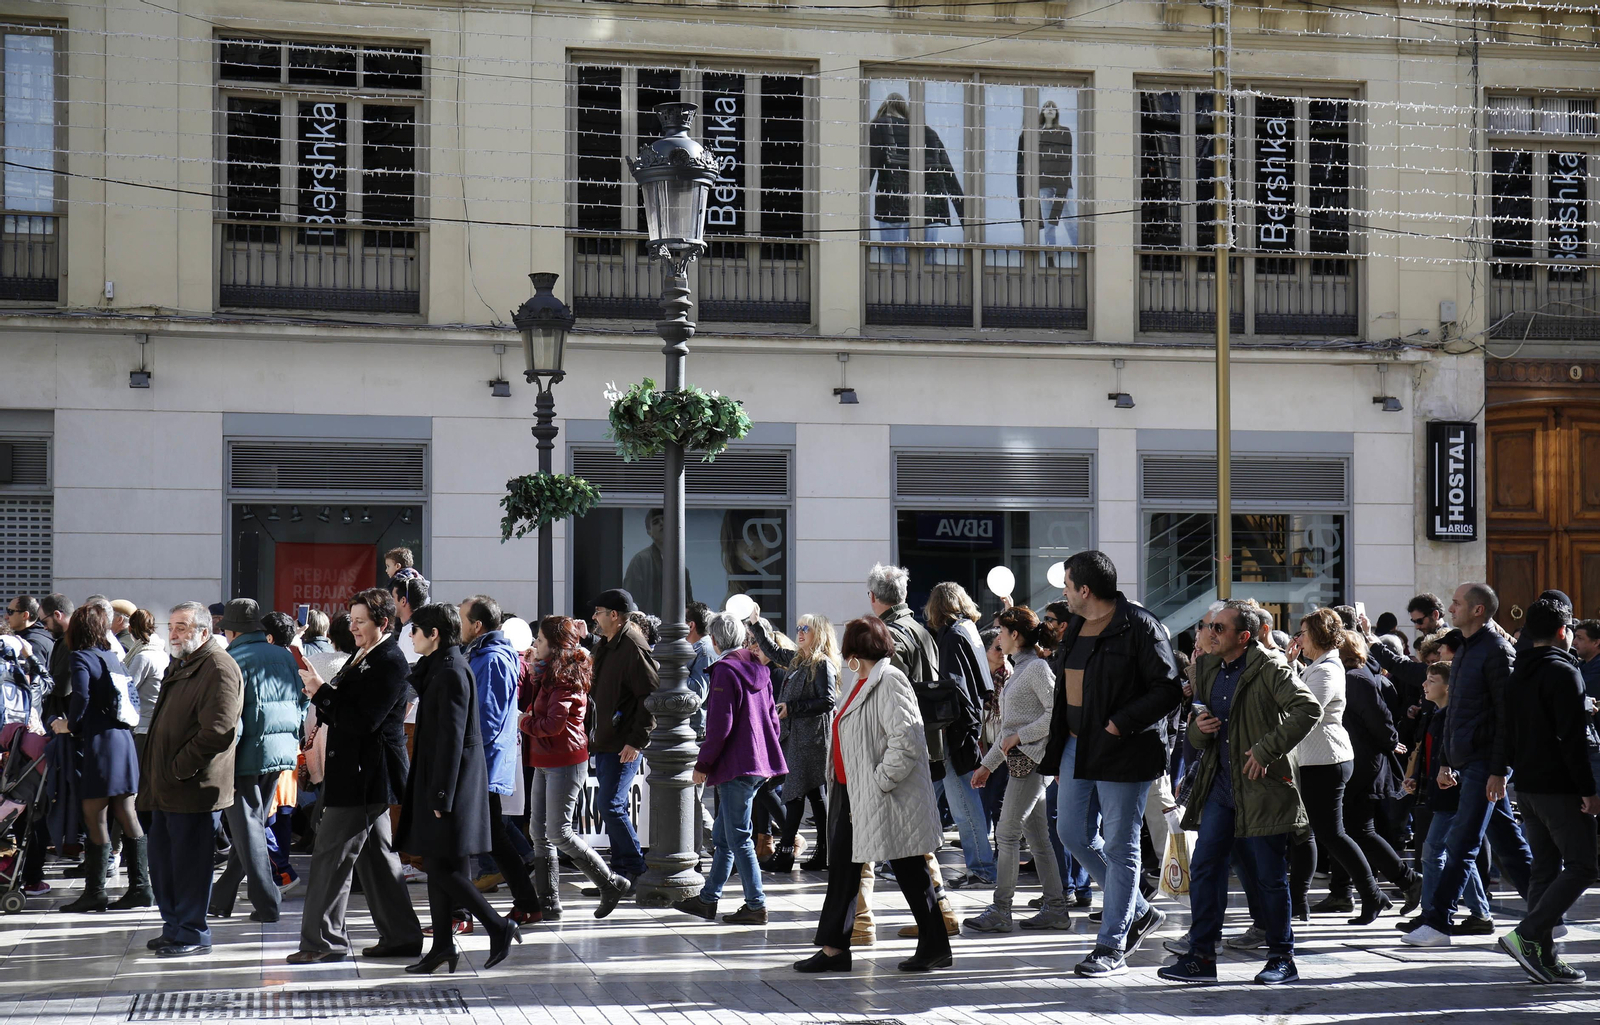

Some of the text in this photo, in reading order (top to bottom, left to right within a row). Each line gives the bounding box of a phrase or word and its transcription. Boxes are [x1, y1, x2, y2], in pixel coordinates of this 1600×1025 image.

[306, 103, 336, 235] Bershka
[708, 97, 737, 225] Bershka
[1260, 119, 1287, 242] Bershka
[1448, 430, 1465, 521] HOSTAL
[1435, 515, 1473, 533] LARIOS
[292, 584, 356, 599] REBAJAS
[293, 568, 357, 583] REBAJAS
